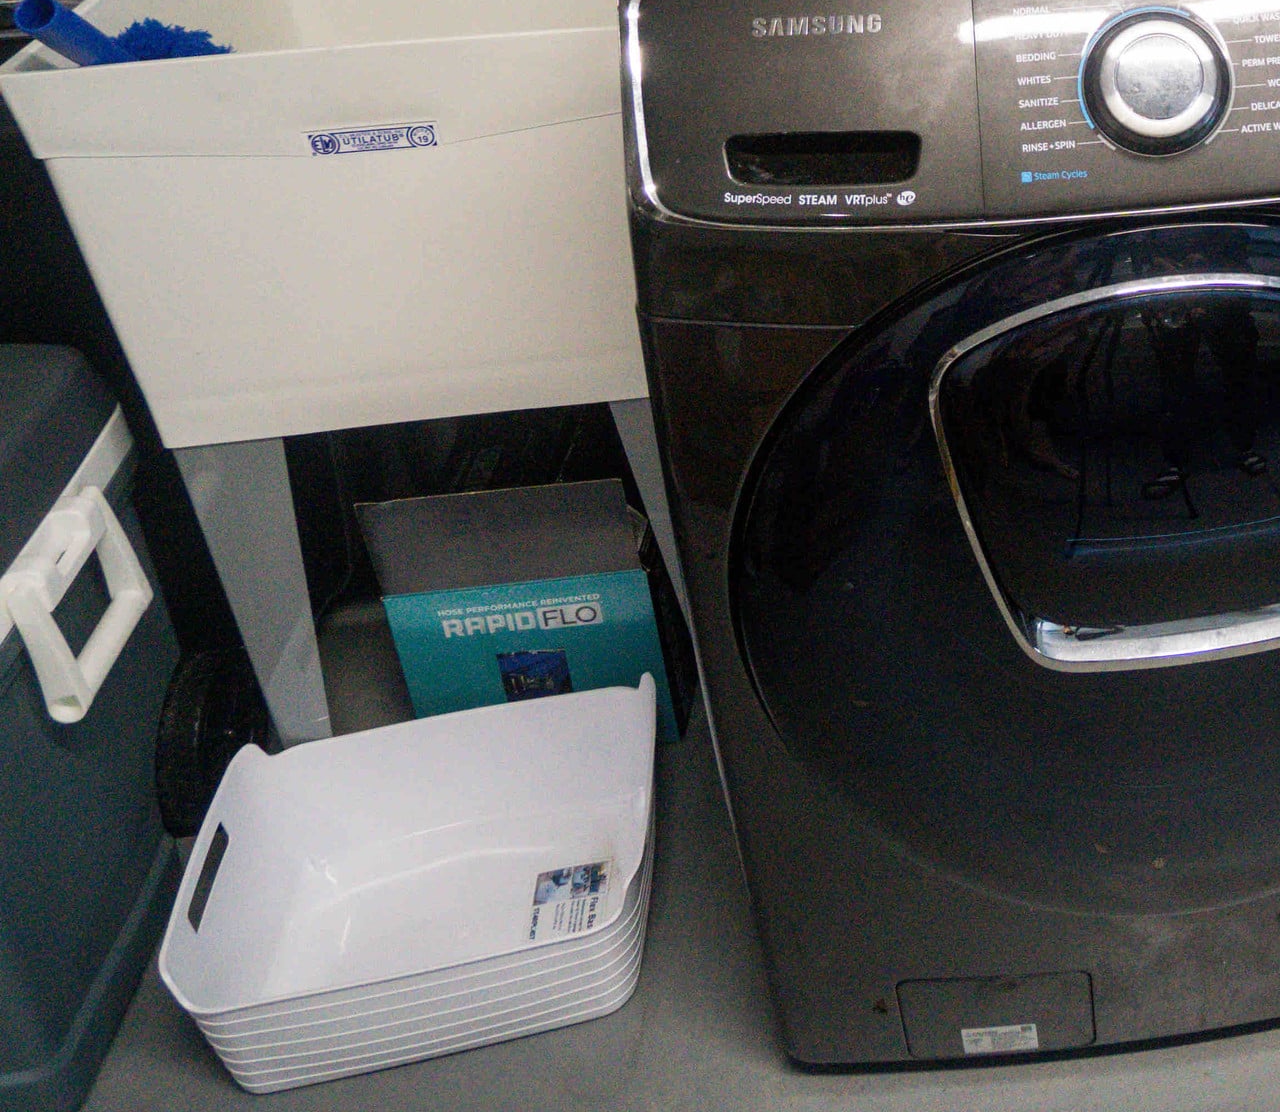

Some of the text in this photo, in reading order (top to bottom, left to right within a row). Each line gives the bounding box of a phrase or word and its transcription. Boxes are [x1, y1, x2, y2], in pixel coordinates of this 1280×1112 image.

[752, 13, 882, 37] SAMSUNG
[1016, 52, 1056, 63] BEDDING
[1242, 57, 1266, 67] PERM
[1017, 75, 1051, 86] WHITES
[1018, 98, 1059, 109] SANITIZE
[1020, 119, 1066, 131] ALLERGEN
[1241, 123, 1273, 134] ACTIVE
[1034, 169, 1088, 182] Steam Cycles
[724, 192, 792, 206] SuperSpeed
[799, 194, 837, 205] STEAM
[437, 593, 600, 617] HOSE PERFORMANCE REINVENTED
